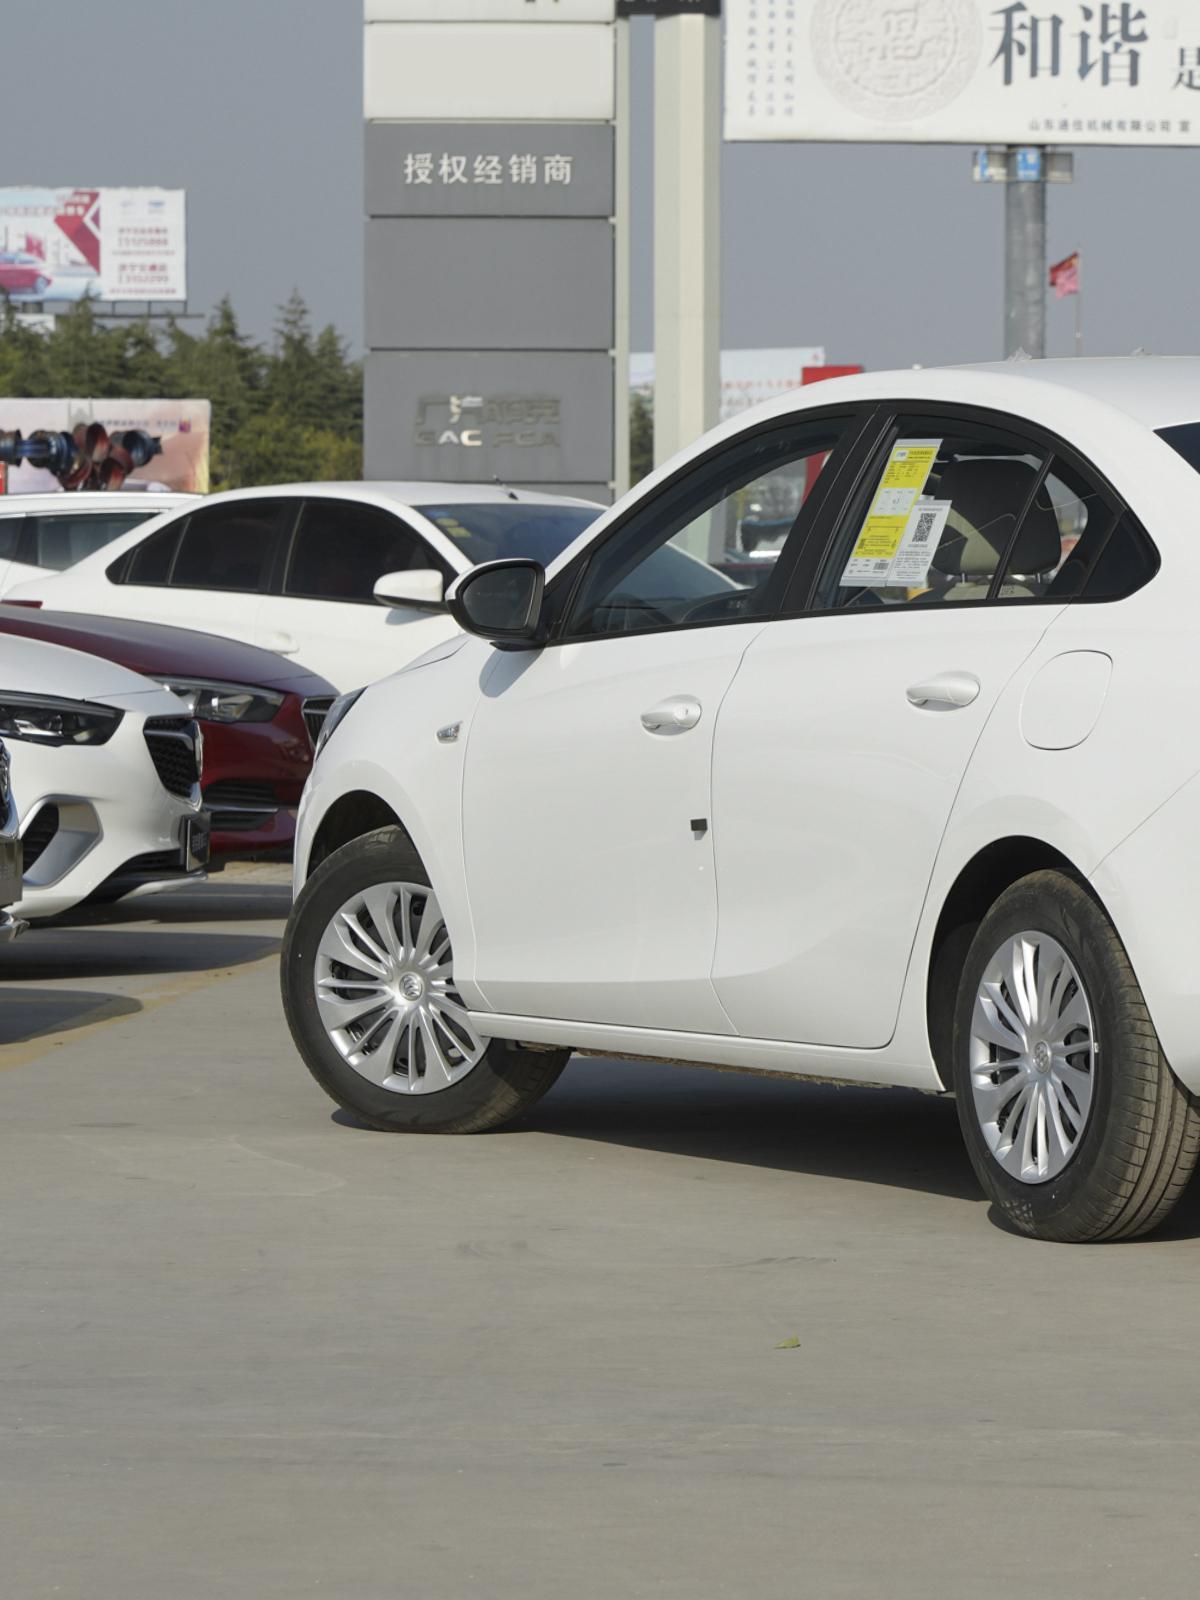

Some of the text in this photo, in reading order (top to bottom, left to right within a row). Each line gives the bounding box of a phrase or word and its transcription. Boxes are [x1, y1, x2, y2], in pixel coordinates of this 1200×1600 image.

[988, 2, 1149, 87] 和谐
[403, 152, 574, 185] 授权经销商
